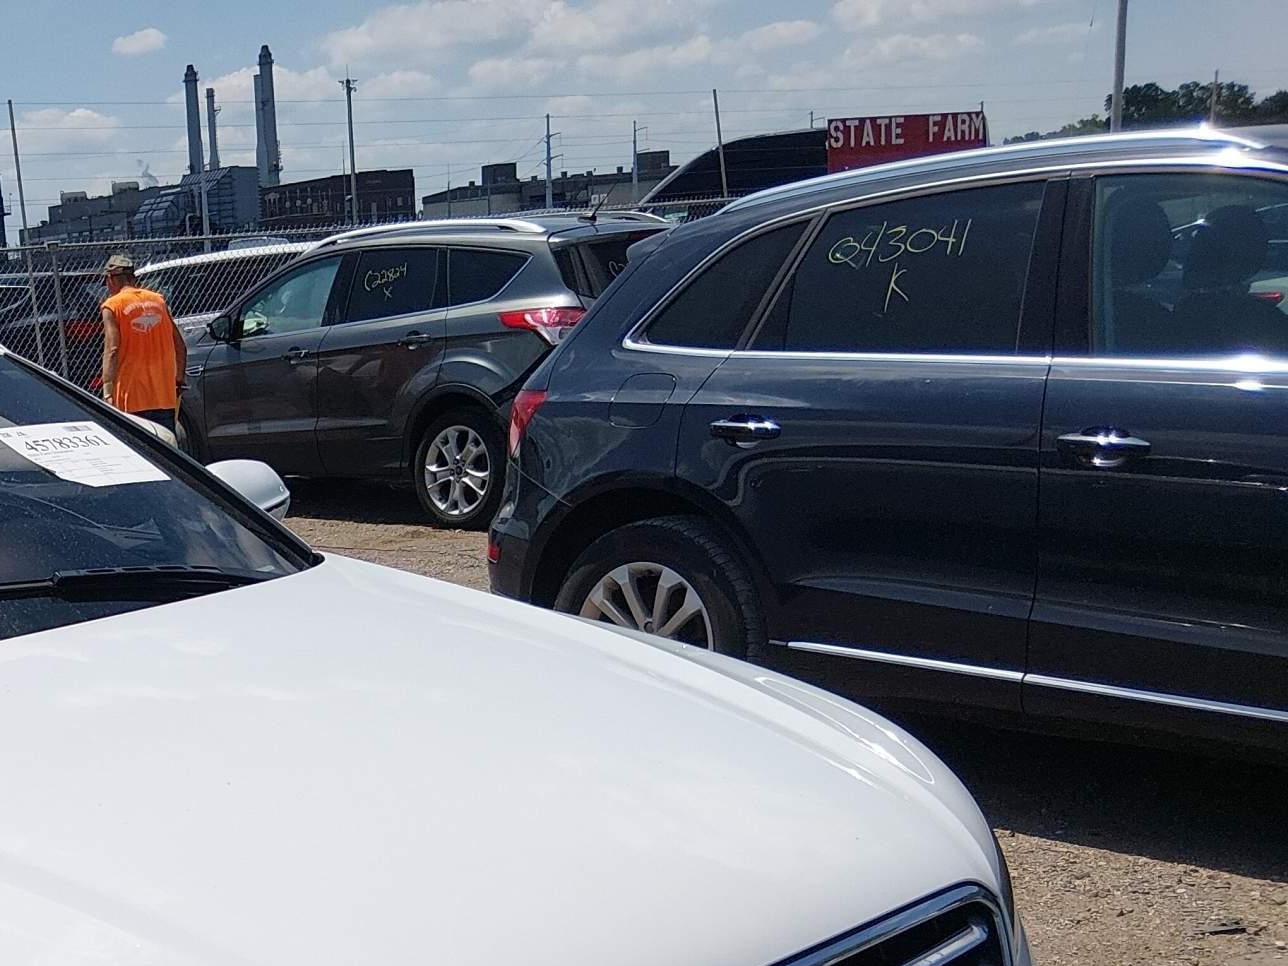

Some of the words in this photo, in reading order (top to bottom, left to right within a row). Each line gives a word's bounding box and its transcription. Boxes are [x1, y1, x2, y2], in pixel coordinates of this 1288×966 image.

[829, 117, 905, 149] STATE
[928, 112, 984, 142] FARM
[883, 262, 910, 313] K
[24, 435, 111, 453] 45783361
